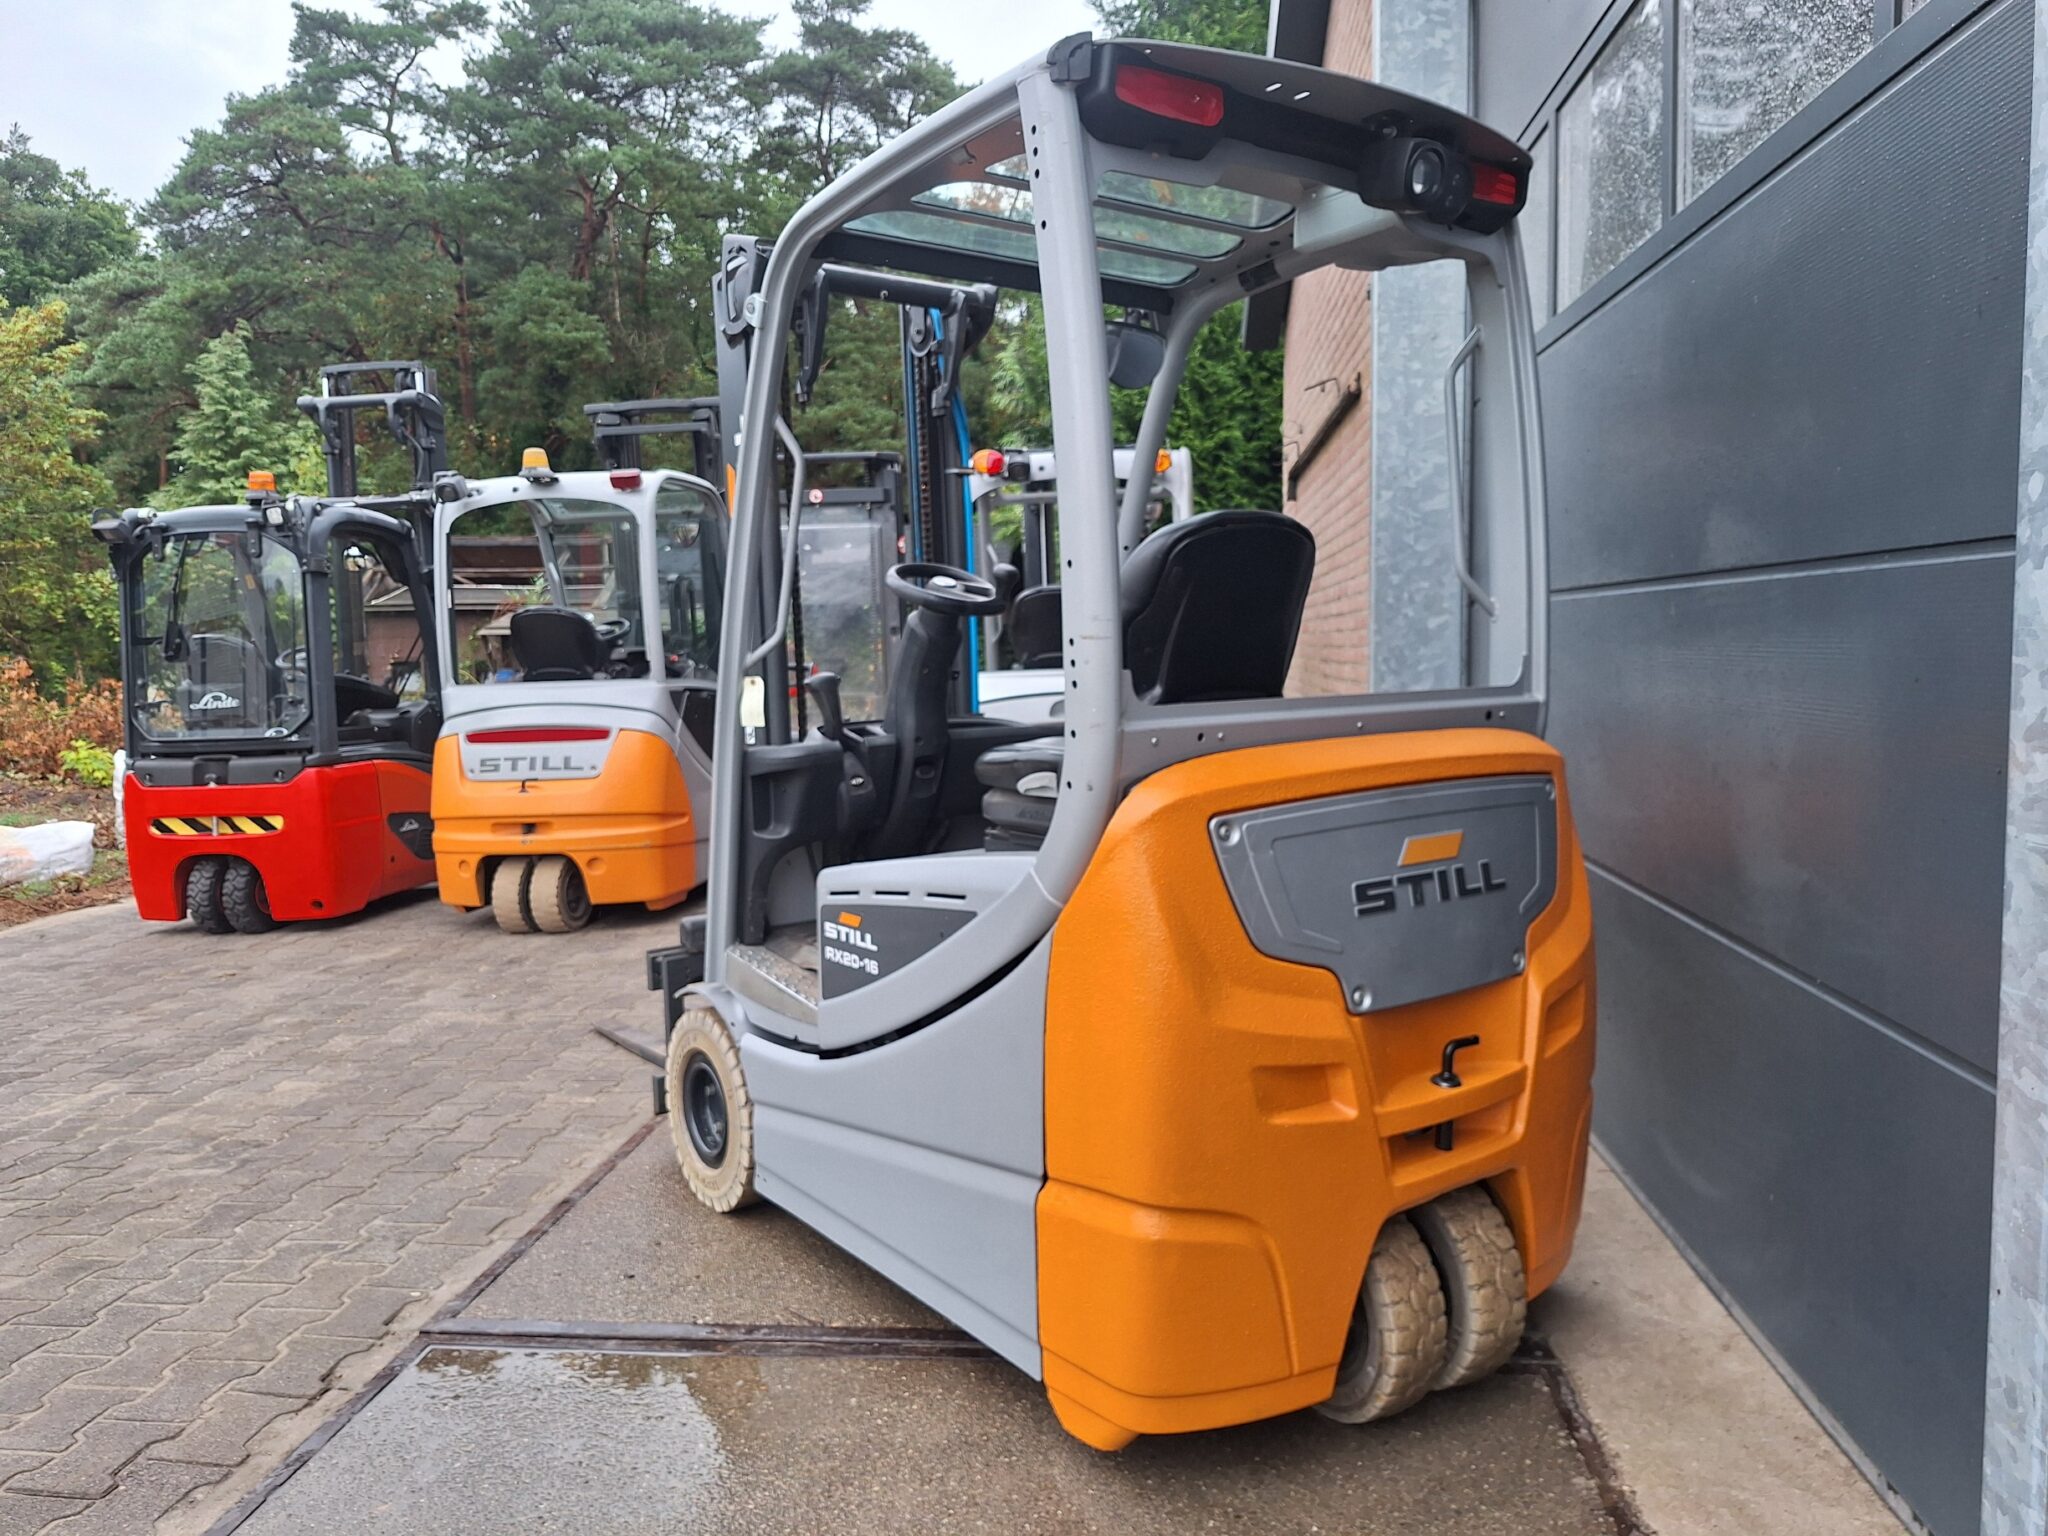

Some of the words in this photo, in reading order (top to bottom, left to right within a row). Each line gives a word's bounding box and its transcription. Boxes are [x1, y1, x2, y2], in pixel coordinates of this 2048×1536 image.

[189, 691, 241, 711] Linde
[480, 756, 584, 773] STILL
[1352, 859, 1506, 917] STILL
[823, 921, 879, 952] STILL
[824, 945, 880, 976] RX20-16
